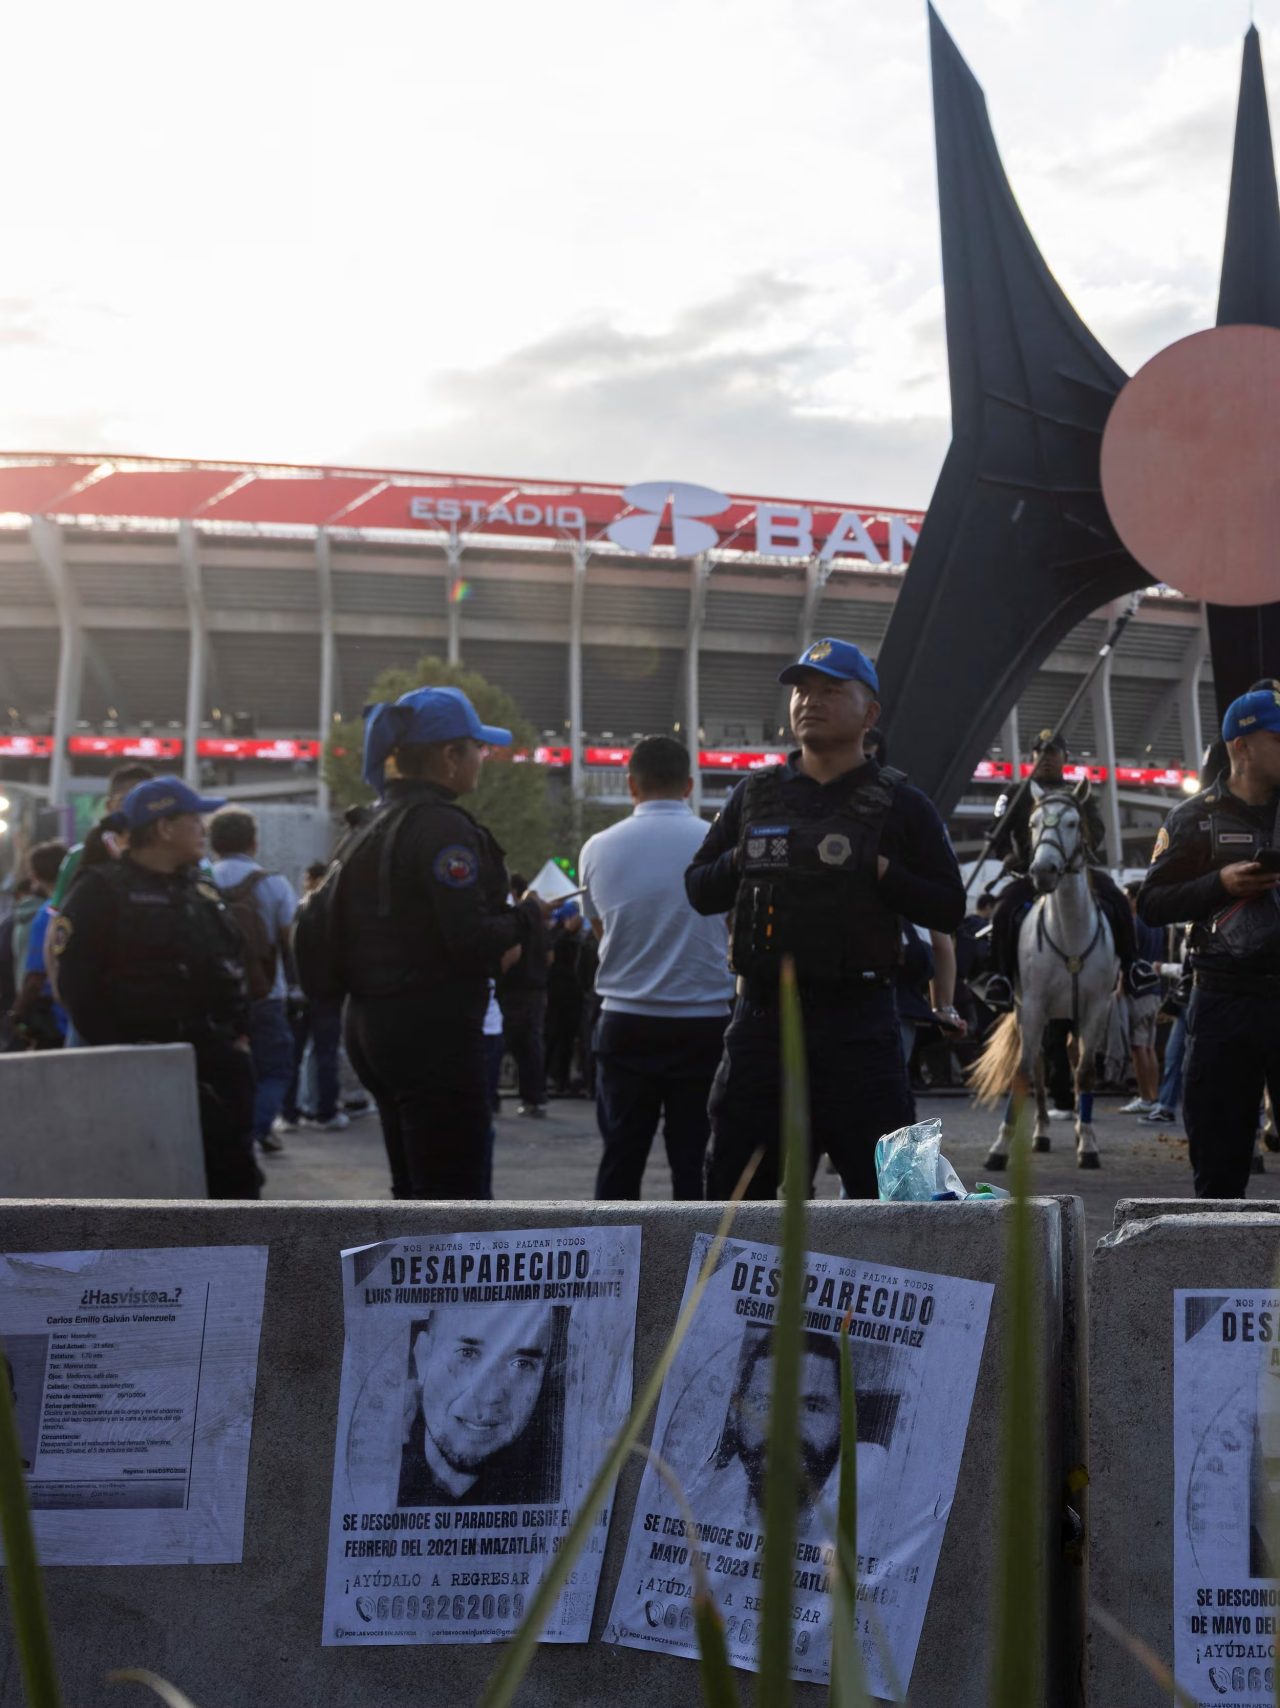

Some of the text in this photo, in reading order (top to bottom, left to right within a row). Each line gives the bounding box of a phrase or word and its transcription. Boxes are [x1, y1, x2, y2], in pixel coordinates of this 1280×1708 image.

[410, 497, 586, 529] ESTADIO
[404, 1238, 586, 1252] NOS FALTAS TÚ, NOS FALTAN TODOS
[751, 1251, 767, 1262] NOS
[390, 1249, 590, 1285] DESAPARECIDO
[839, 1266, 856, 1278] NOS
[862, 1272, 899, 1285] FALTAN
[904, 1278, 934, 1291] TODOS
[365, 1282, 621, 1304] LUIS HUMBERTO VALDELAMAR BUSTAMANTE
[731, 1262, 935, 1326] DESPARECIDO
[1236, 1298, 1254, 1307] NOS
[47, 1316, 72, 1324] Carlos
[102, 1315, 130, 1323] Galván
[133, 1314, 176, 1323] Valenzuela
[735, 1296, 925, 1348] CÉSAR PÁEZ
[342, 1514, 358, 1531] SE
[361, 1513, 431, 1530] DESCONOCE
[434, 1512, 450, 1529] SU
[454, 1511, 517, 1528] PARADERO
[643, 1513, 752, 1550] SE SU
[345, 1533, 548, 1557] FEBRERO DEL 2021 EN MAZATLÁN,
[649, 1542, 687, 1565] MAYO
[714, 1555, 749, 1577] 2023
[345, 1570, 530, 1594] ¡AYÚDALO A REGRESAR
[377, 1593, 524, 1620] 6693262089
[724, 1593, 734, 1606] A
[1197, 1588, 1212, 1607] SE
[1191, 1616, 1208, 1634] DE
[1212, 1616, 1250, 1634] MAYO
[1256, 1617, 1277, 1635] DEL
